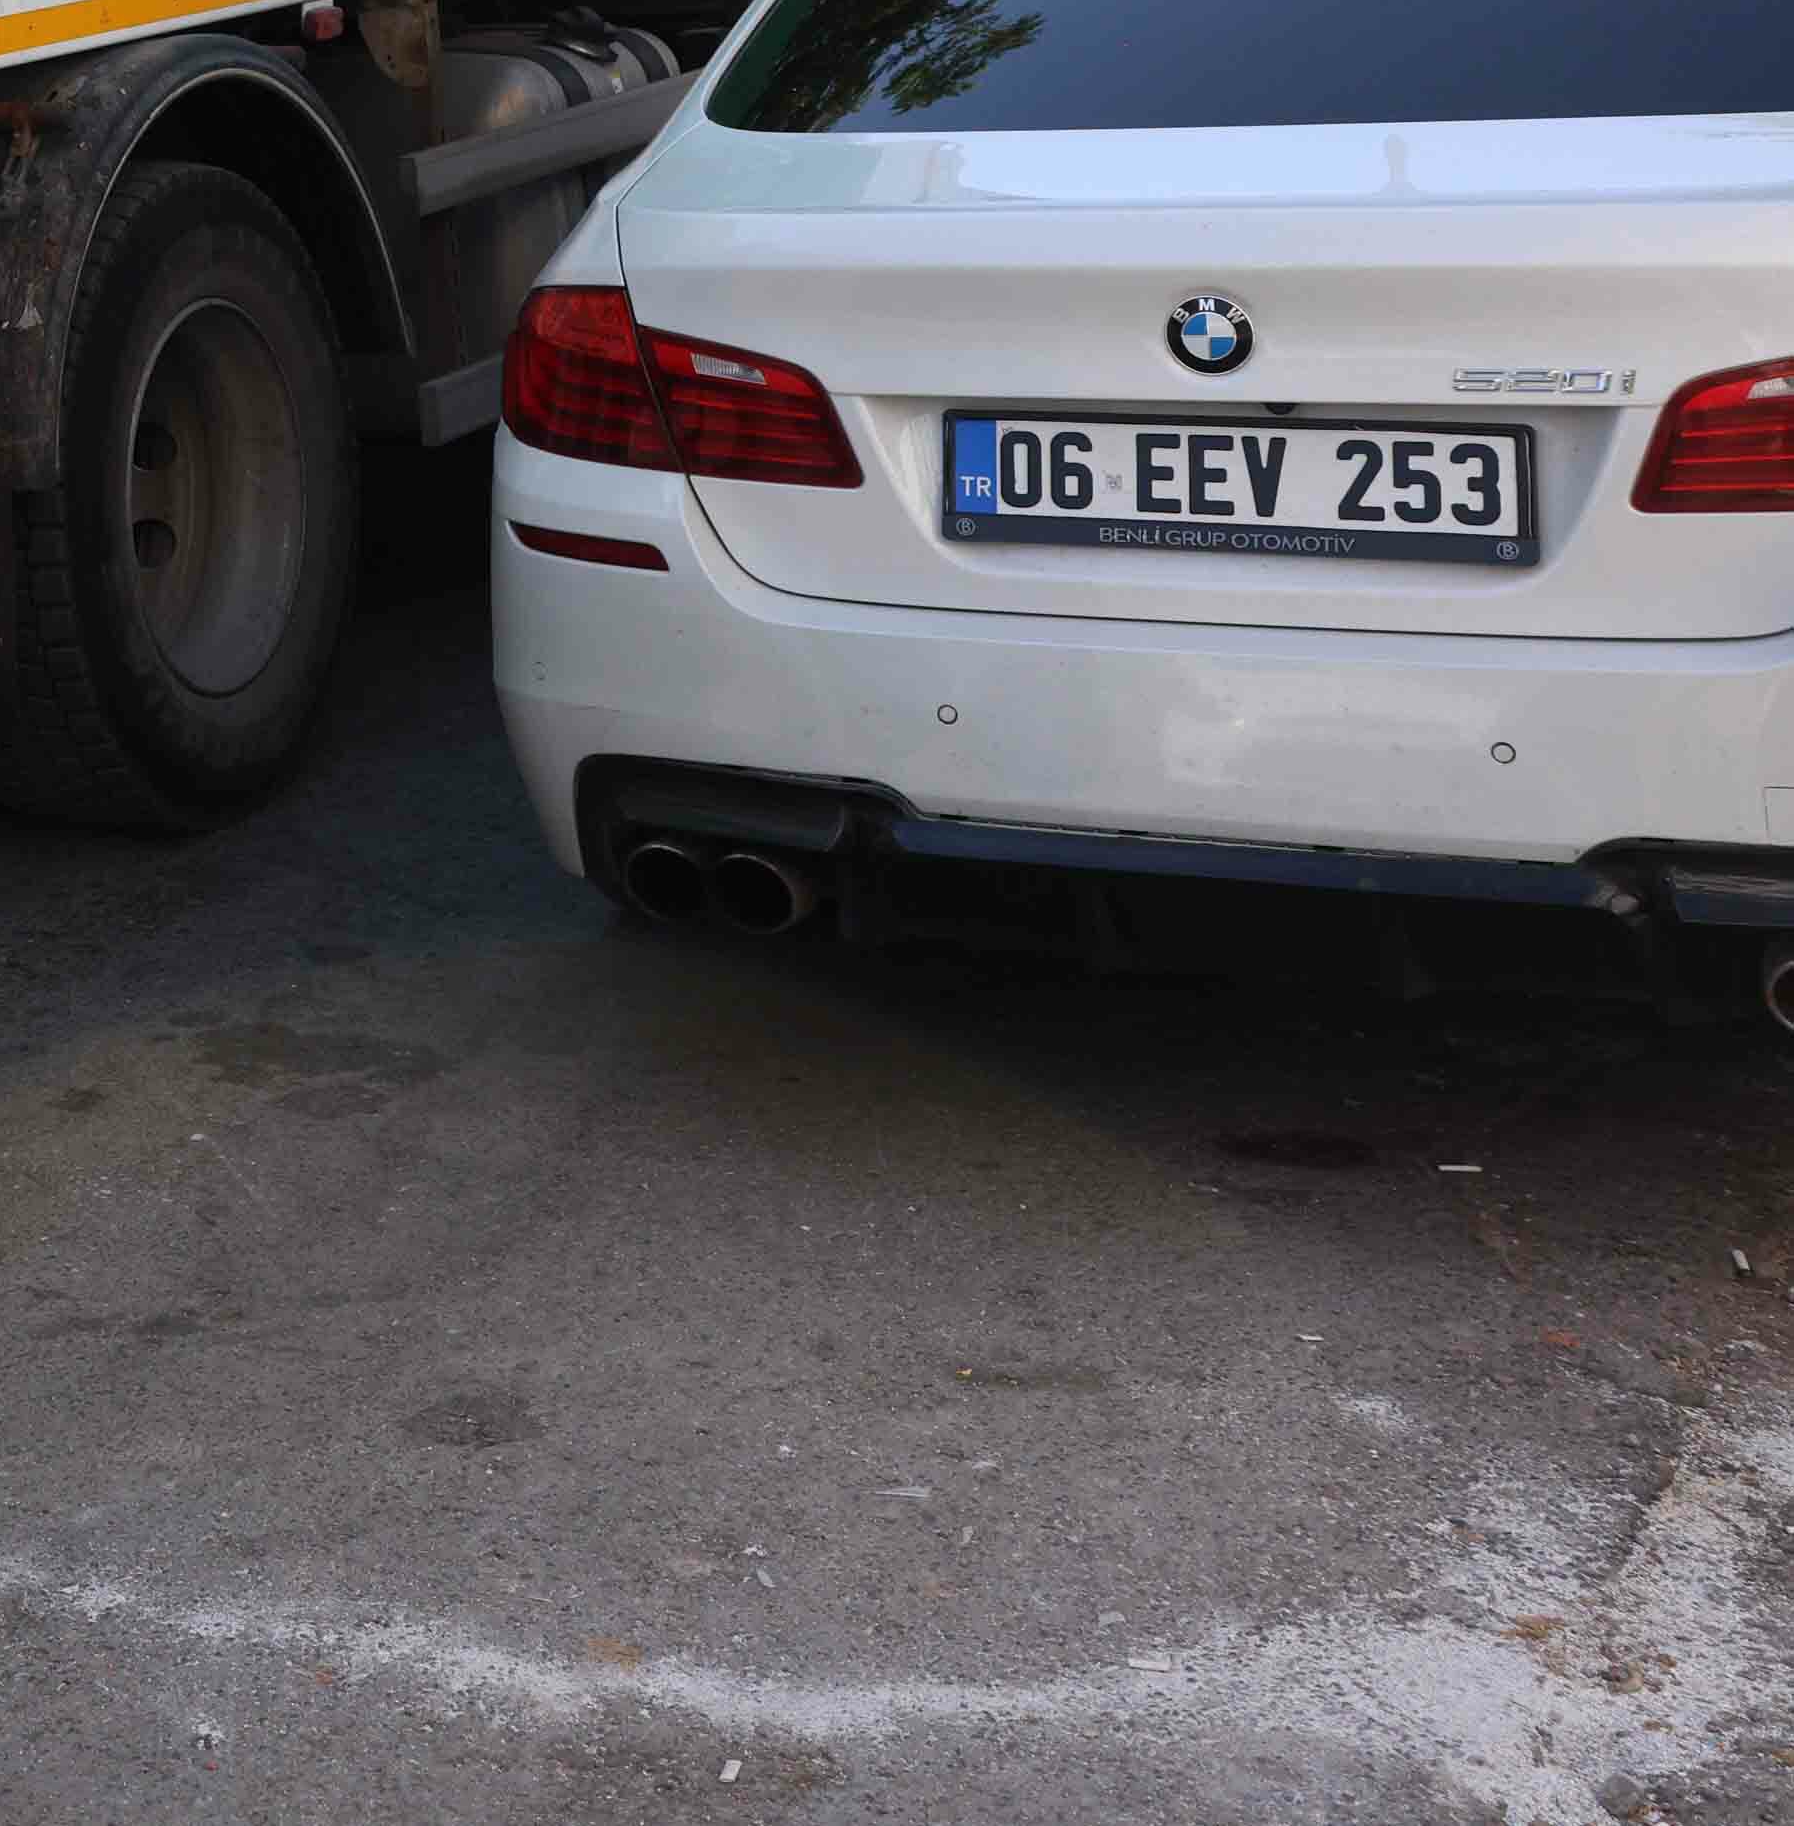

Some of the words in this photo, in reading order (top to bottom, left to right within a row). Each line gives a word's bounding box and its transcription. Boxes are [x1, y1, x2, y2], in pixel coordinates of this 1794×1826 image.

[959, 475, 992, 497] TR
[1000, 429, 1094, 511] 06
[1134, 432, 1288, 518] EEV
[1336, 439, 1502, 527] 253
[1099, 525, 1161, 545] BENLİ
[1165, 529, 1226, 548] GRUP
[1230, 533, 1356, 554] OTOMOTİV
